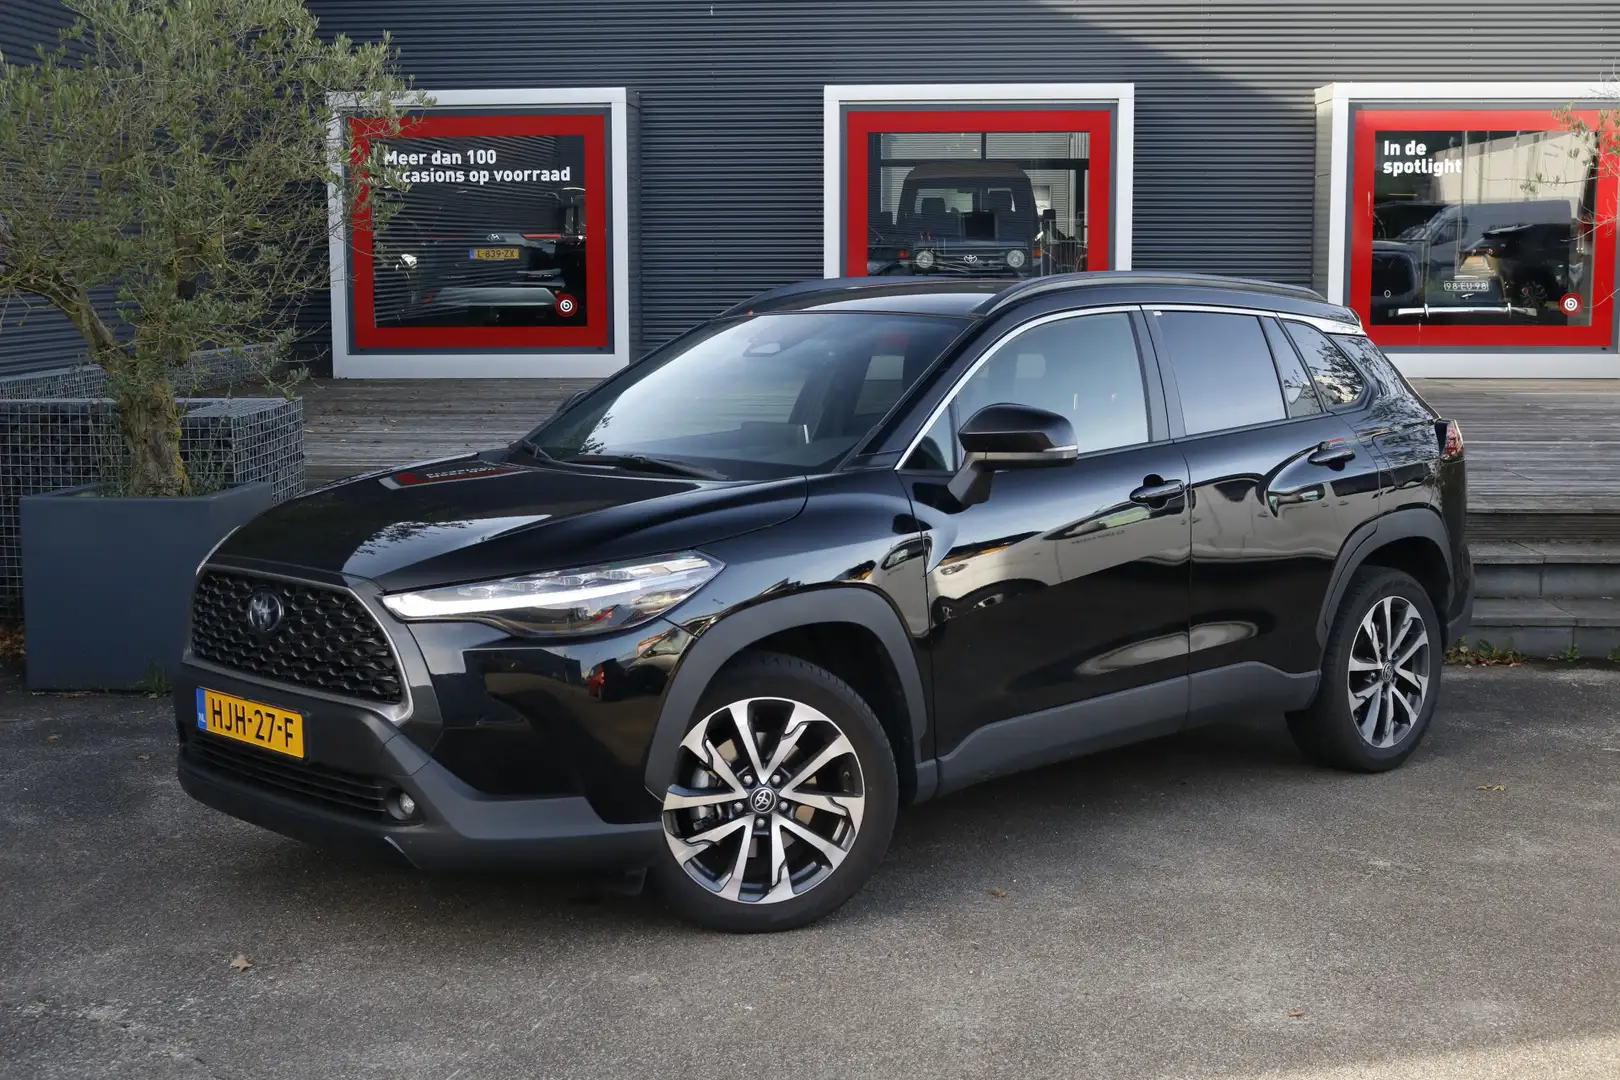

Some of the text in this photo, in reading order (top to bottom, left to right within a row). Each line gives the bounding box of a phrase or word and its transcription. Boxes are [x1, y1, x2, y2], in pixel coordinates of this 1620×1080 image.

[1384, 140, 1427, 156] In de
[384, 149, 497, 165] Meer dan 100
[469, 172, 490, 185] op
[493, 166, 571, 182] voorraad
[1383, 158, 1462, 177] spotlight
[1446, 282, 1487, 290] 98-EU-98
[211, 697, 294, 748] HJH-27-F
